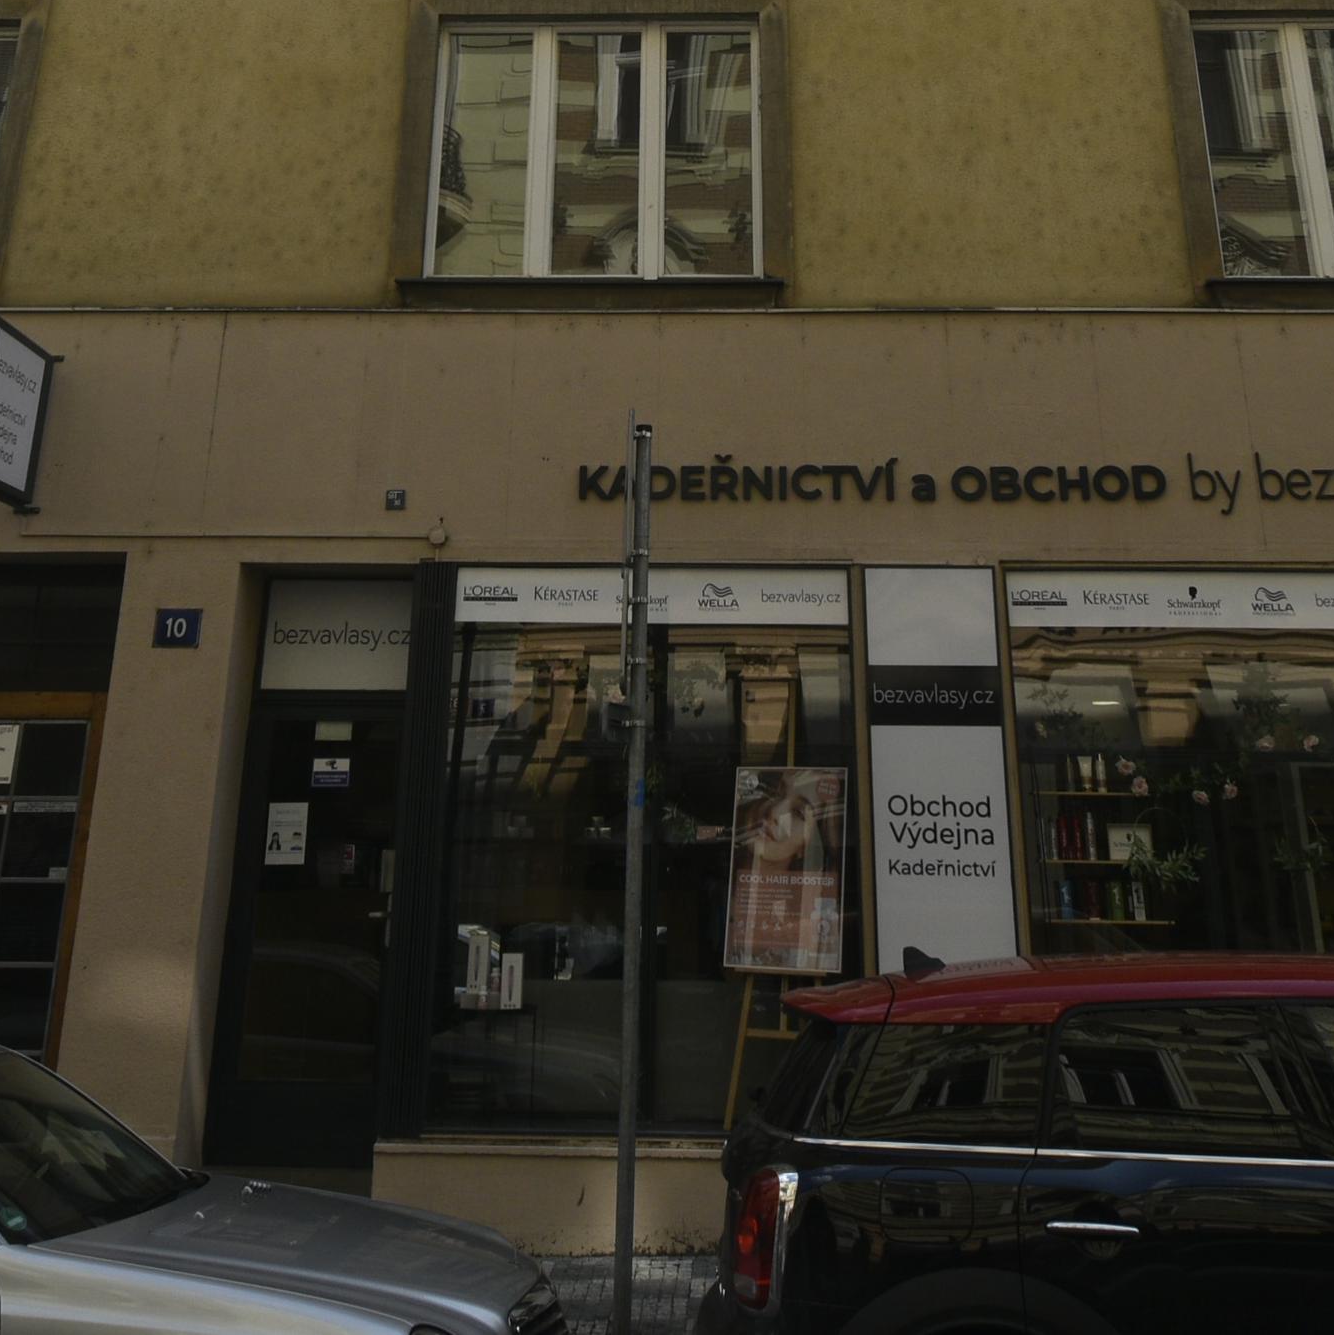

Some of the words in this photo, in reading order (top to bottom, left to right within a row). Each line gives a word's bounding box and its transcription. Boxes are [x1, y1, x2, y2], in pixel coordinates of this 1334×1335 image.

[911, 473, 937, 503] a
[951, 465, 1168, 503] OBCHOD
[1187, 452, 1241, 515] by
[534, 585, 599, 602] KÉRASTASE
[698, 598, 740, 608] WELLA
[761, 588, 842, 607] bezvavlasy.cz
[1083, 589, 1150, 606] KÉRASTASE
[1167, 599, 1222, 610] Schwarzkopf
[1251, 602, 1295, 612] WELLA
[165, 617, 188, 640] 10
[273, 621, 412, 652] bezvavlasy.cz
[873, 682, 996, 710] bezvavlasy.cz
[888, 794, 991, 818] Obchod
[889, 821, 995, 851] Výdejna
[766, 874, 789, 885] HAIR
[889, 859, 996, 878] Kadeřnictví
